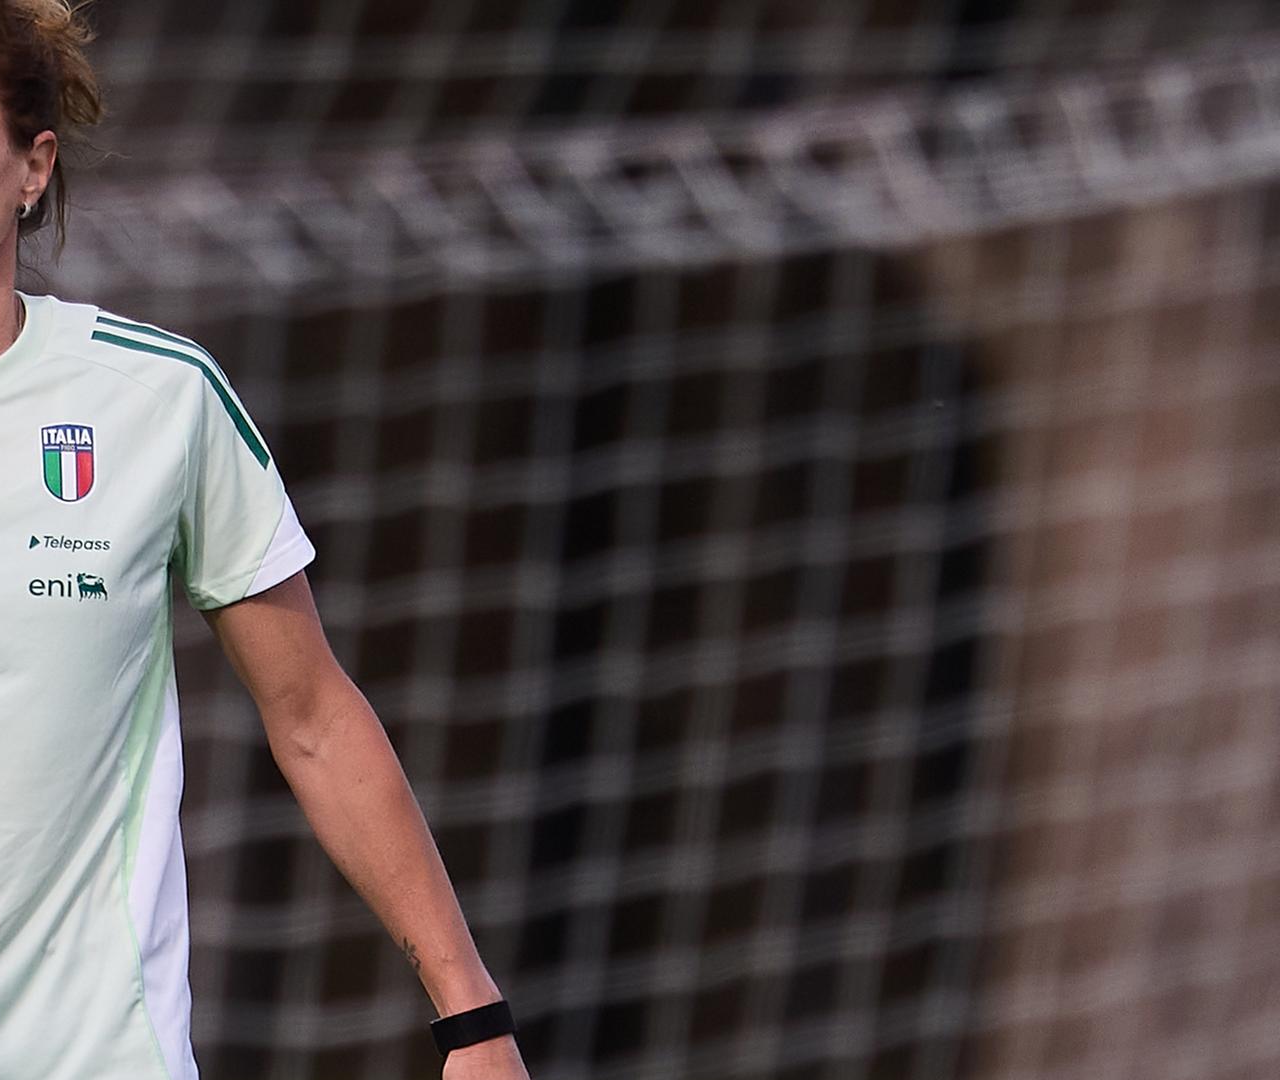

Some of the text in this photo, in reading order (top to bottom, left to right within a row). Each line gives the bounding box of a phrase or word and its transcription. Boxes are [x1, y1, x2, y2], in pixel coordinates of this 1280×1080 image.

[43, 428, 92, 445] ITALIA
[43, 535, 111, 552] Telepass
[29, 573, 72, 598] eni
